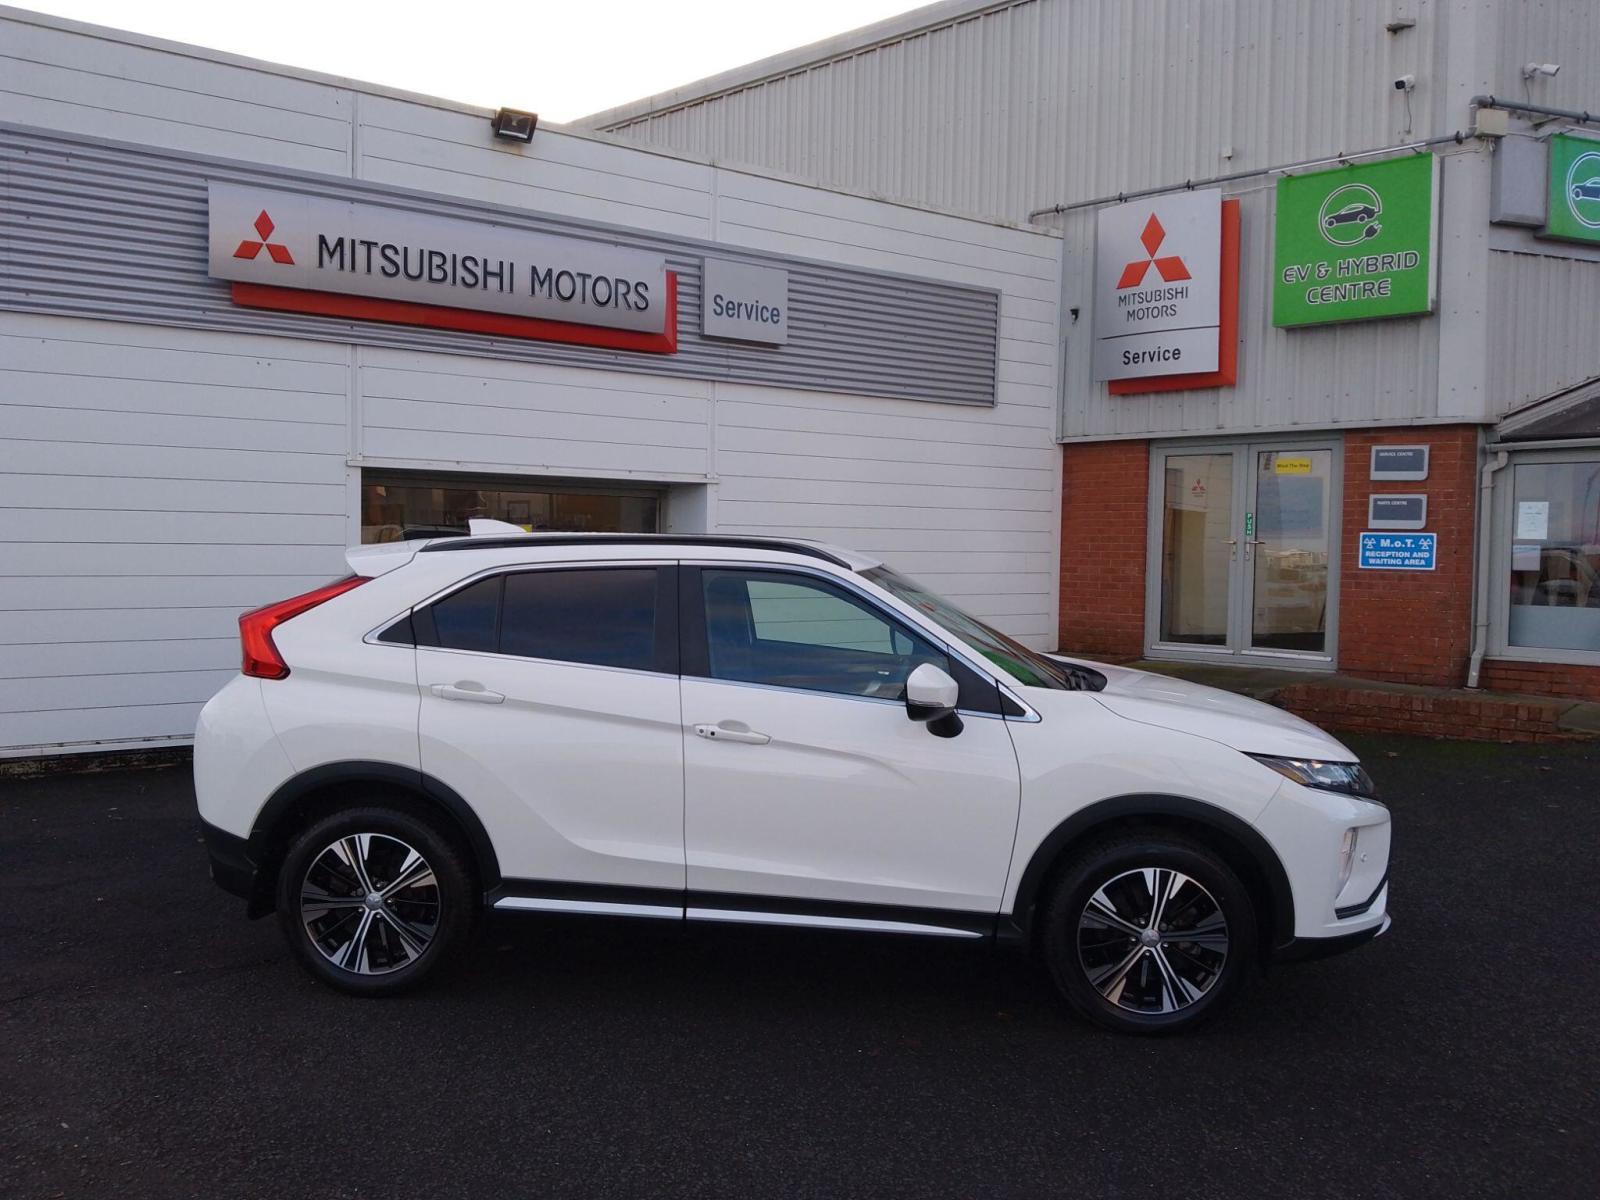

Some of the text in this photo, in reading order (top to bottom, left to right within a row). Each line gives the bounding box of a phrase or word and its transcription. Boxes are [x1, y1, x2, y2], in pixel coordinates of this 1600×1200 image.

[317, 233, 650, 312] MITSUBISHI MOTORS
[1283, 250, 1420, 284] EV & HYBRID
[1118, 286, 1190, 308] MITSUBISHI
[1306, 278, 1392, 305] CENTRE
[712, 294, 781, 325] Service
[1126, 303, 1178, 322] MOTORS
[1122, 346, 1182, 366] Service
[1365, 550, 1411, 558] RECEPTION
[1404, 558, 1426, 566] AREA
